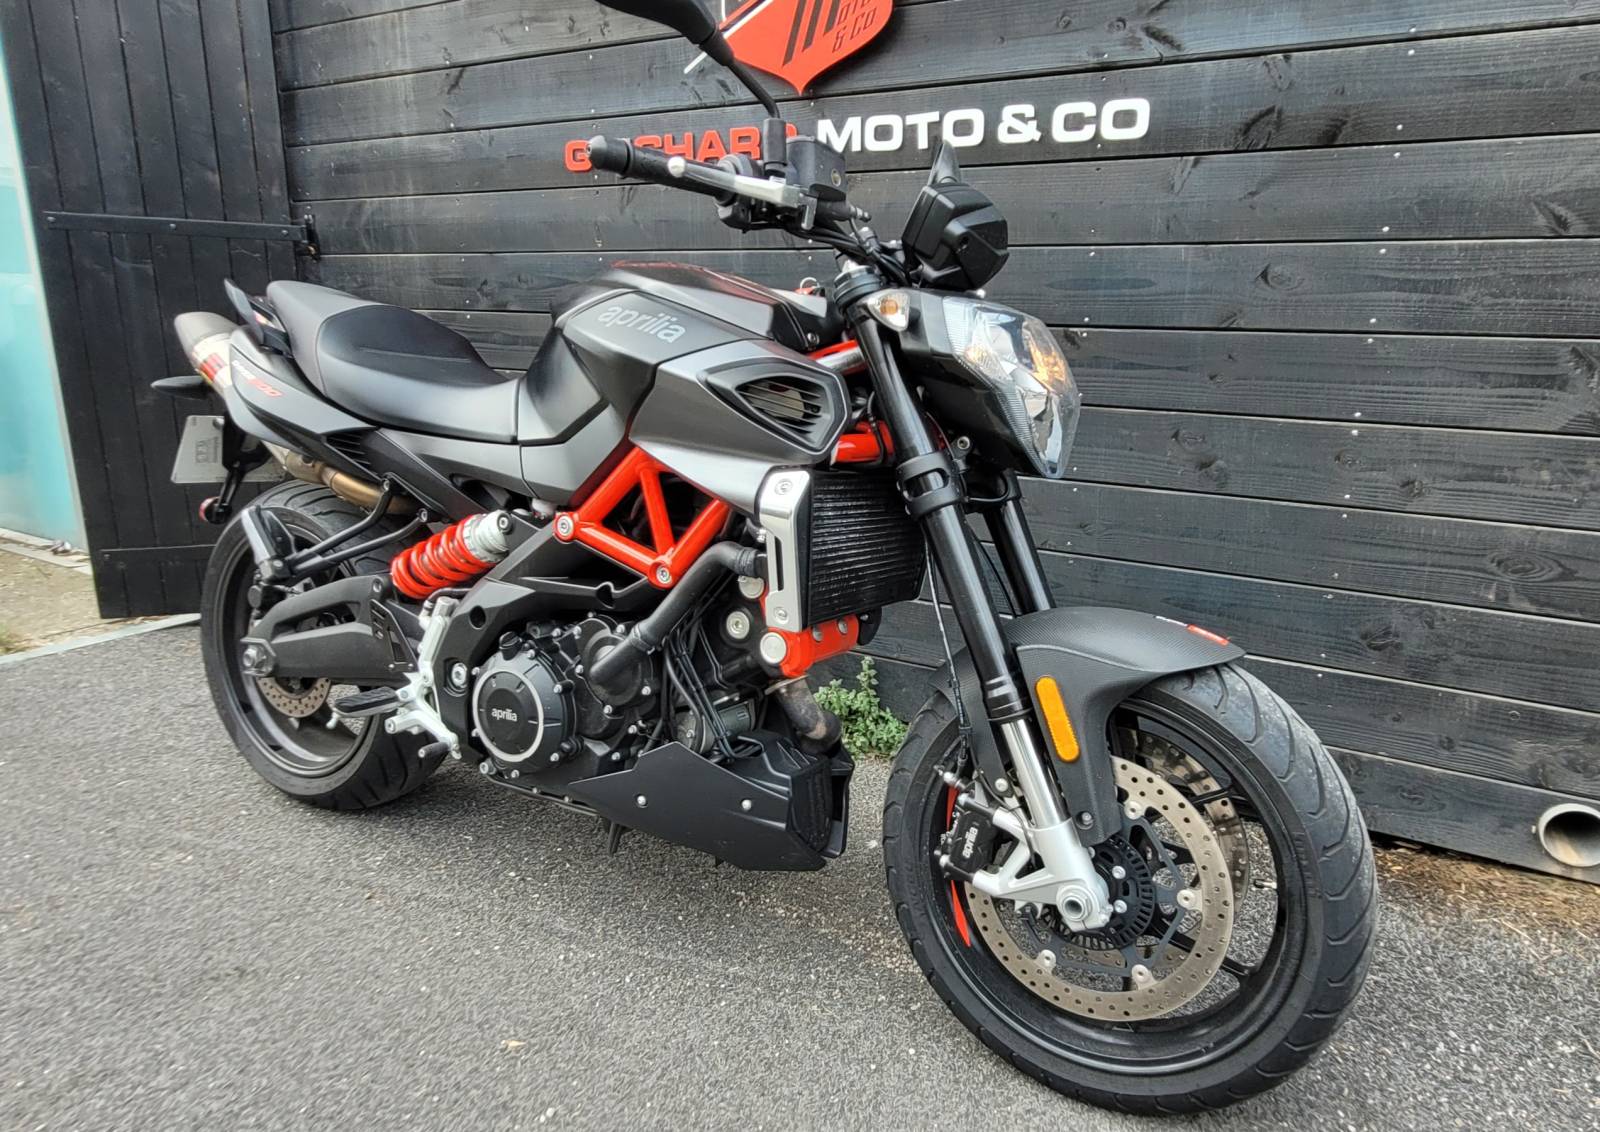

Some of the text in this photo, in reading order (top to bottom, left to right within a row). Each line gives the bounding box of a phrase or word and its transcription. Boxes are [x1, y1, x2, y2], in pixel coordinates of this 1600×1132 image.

[816, 107, 985, 153] MOTO
[997, 103, 1042, 145] &
[1051, 98, 1151, 144] CO
[597, 305, 687, 344] aprilia
[490, 707, 518, 722] aprilia
